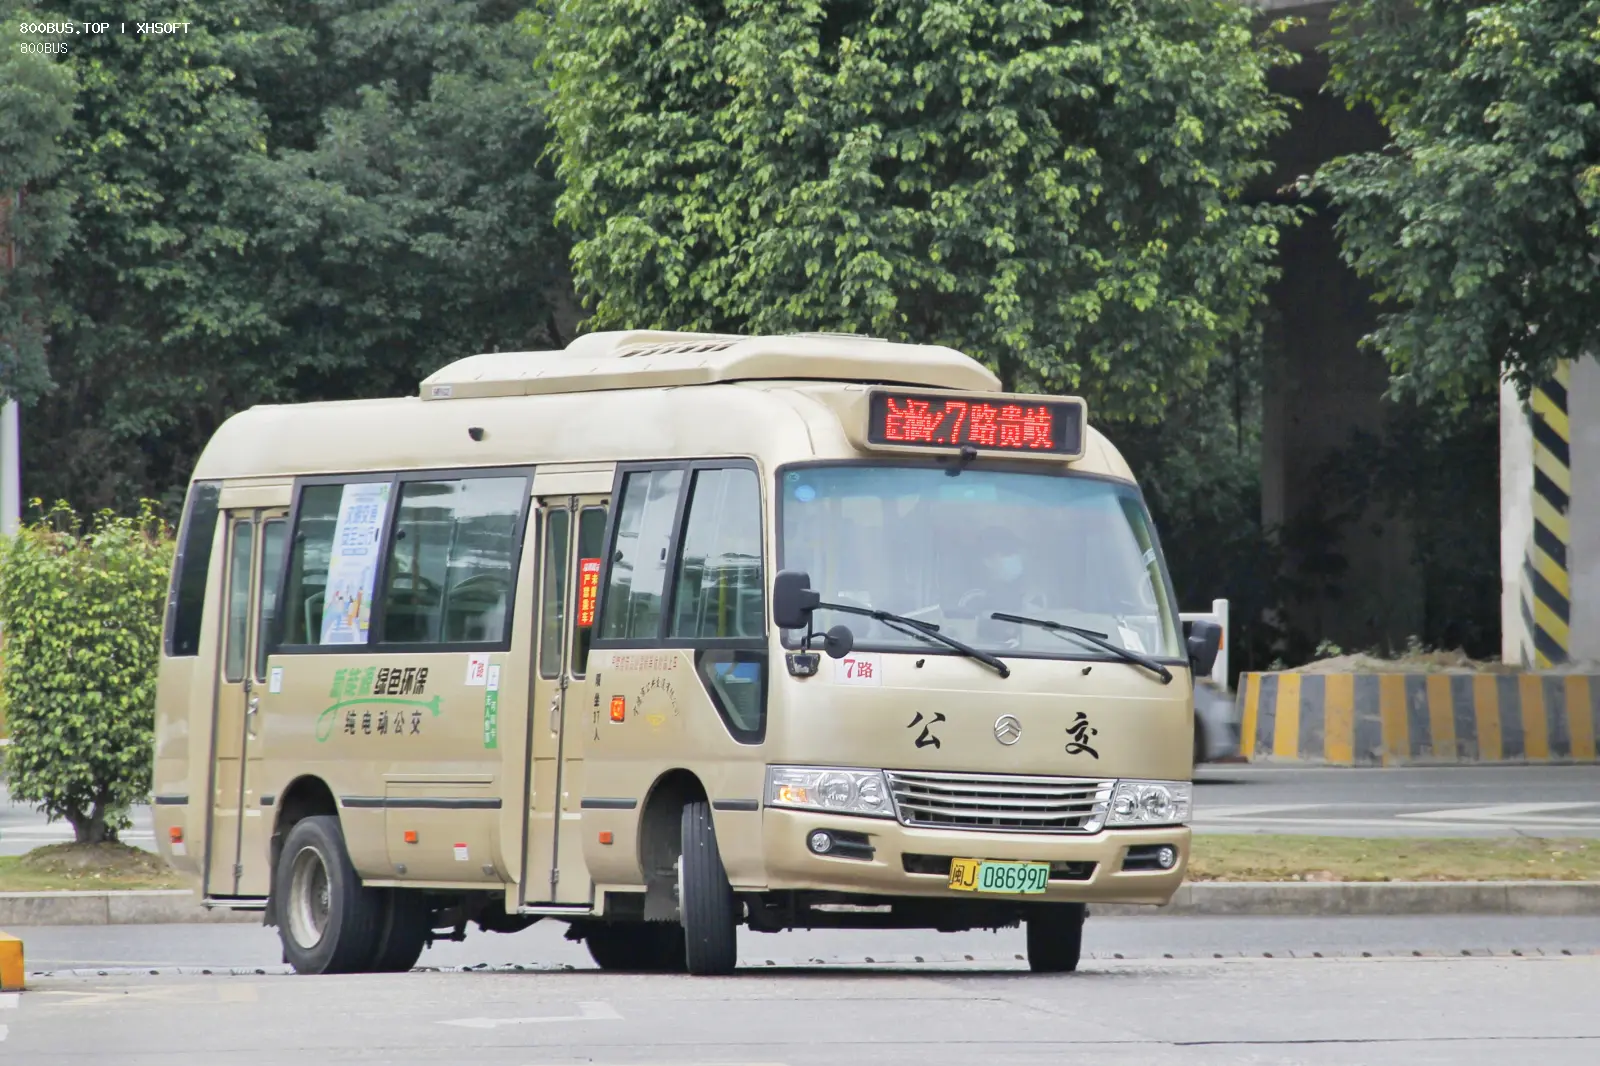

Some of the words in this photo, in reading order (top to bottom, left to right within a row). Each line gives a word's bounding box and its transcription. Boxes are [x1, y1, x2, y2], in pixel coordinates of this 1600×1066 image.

[843, 658, 873, 679] 7路
[344, 710, 422, 736] 纯电动公交
[907, 711, 946, 749] 公
[1065, 711, 1099, 759] 交
